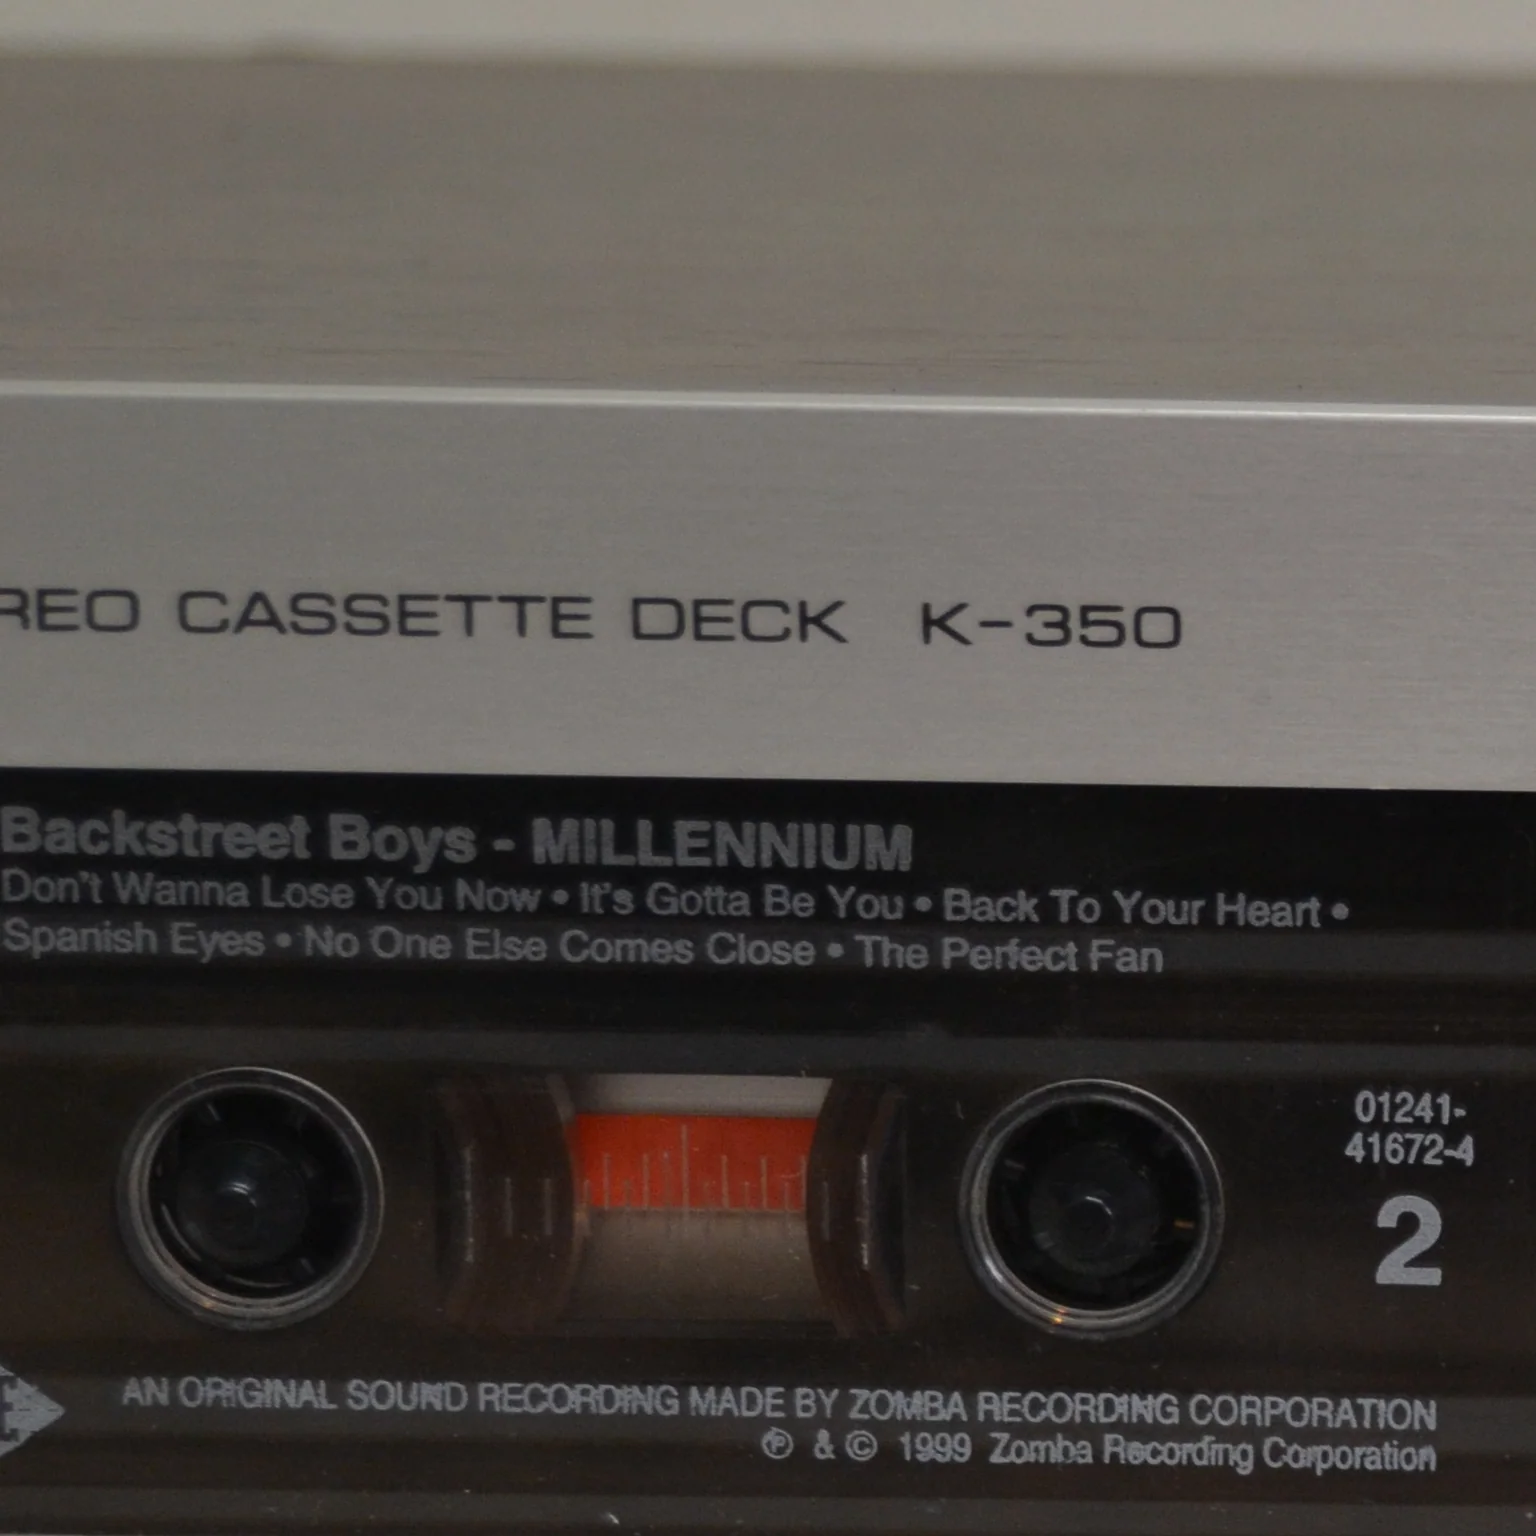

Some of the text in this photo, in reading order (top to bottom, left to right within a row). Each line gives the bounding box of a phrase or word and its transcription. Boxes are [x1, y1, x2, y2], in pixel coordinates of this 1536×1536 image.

[176, 590, 594, 640] CASSETTE
[630, 596, 848, 644] DECK
[921, 602, 1182, 649] K-350
[0, 805, 311, 860] Backstreet
[328, 812, 477, 874] Boys
[531, 816, 913, 872] MILLENNIUM
[0, 866, 1321, 928] Don't Wanna Lose You Now It's Gotta Be You Back To Your Heart
[1, 916, 1164, 973] Spanish Eyes No One Else Comes Close The Perfect Fan
[1344, 1131, 1475, 1167] 41672-4
[1374, 1194, 1443, 1287] 2
[122, 1376, 1437, 1431] AN ORIGINAL SOUND RECORDING MADE BY ZOMBA RECORDING CORPORATION
[813, 1428, 836, 1460] &
[899, 1431, 972, 1463] 1999
[989, 1431, 1094, 1465] Zomba
[1103, 1433, 1255, 1476] Recording
[1262, 1435, 1437, 1476] Corporation
